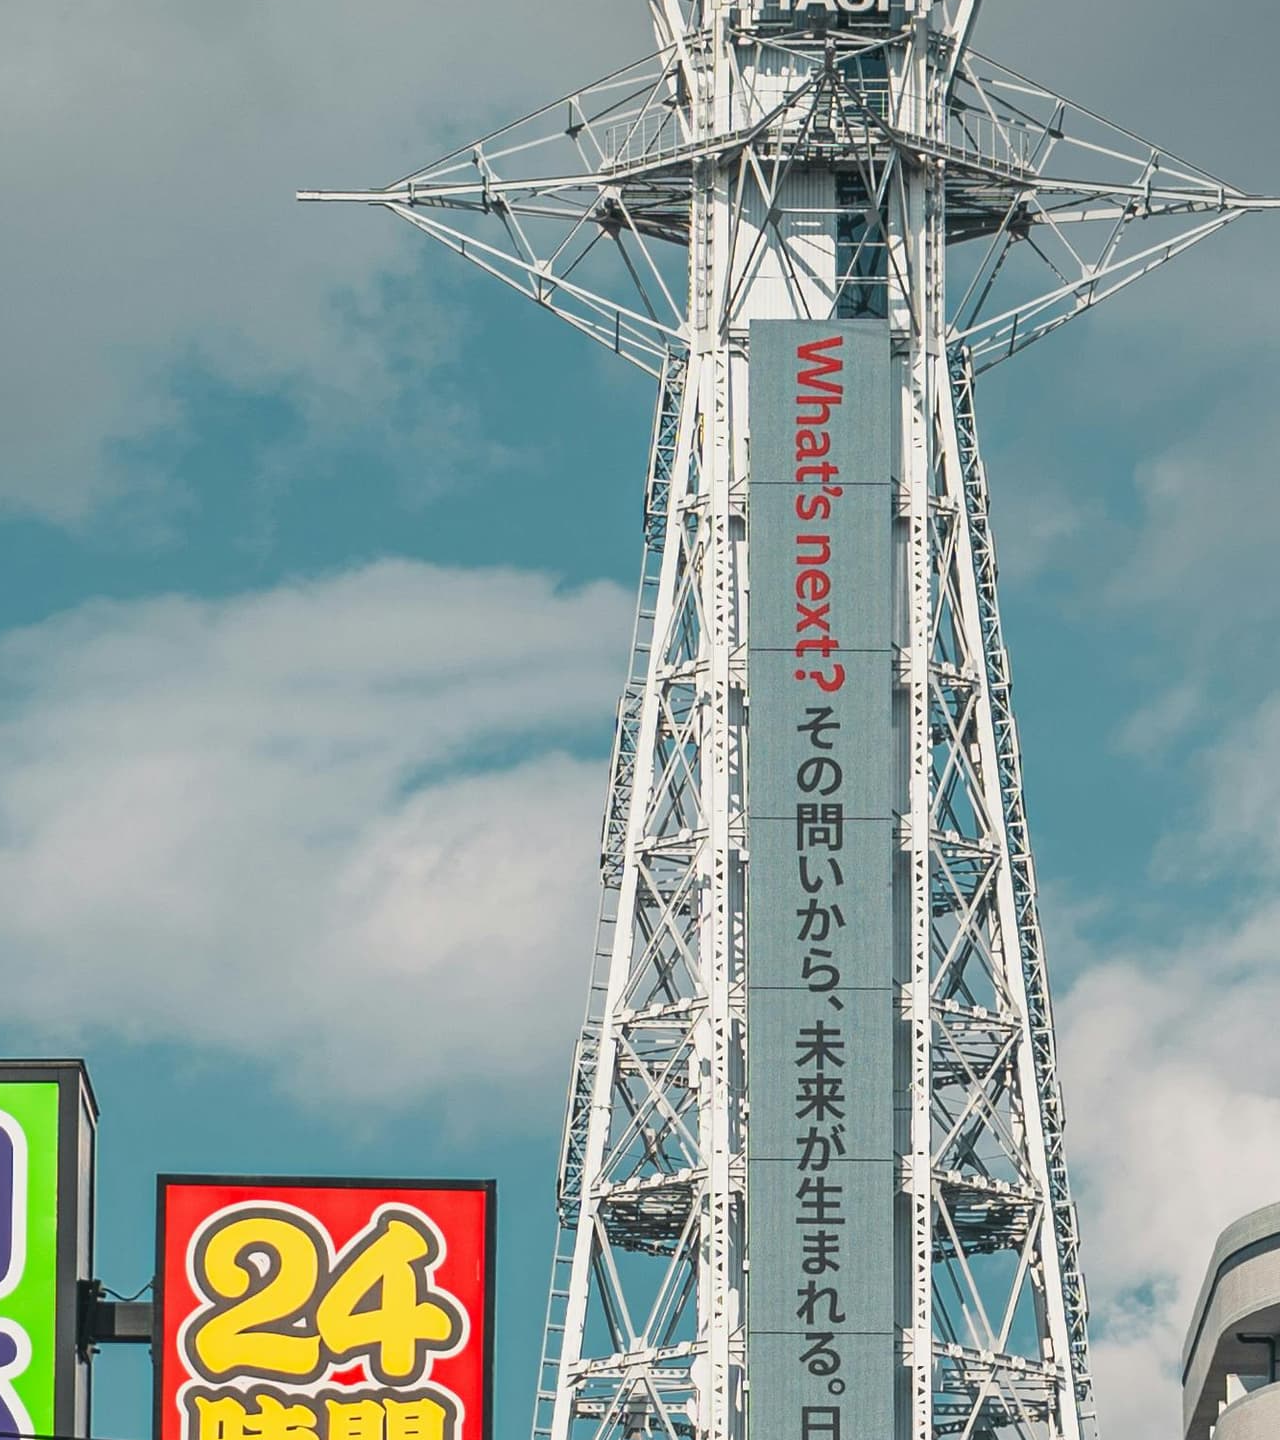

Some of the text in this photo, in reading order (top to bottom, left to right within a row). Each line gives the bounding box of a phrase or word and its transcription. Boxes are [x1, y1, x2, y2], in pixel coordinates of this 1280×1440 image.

[793, 335, 846, 693] What's next?
[194, 1210, 460, 1380] 24
